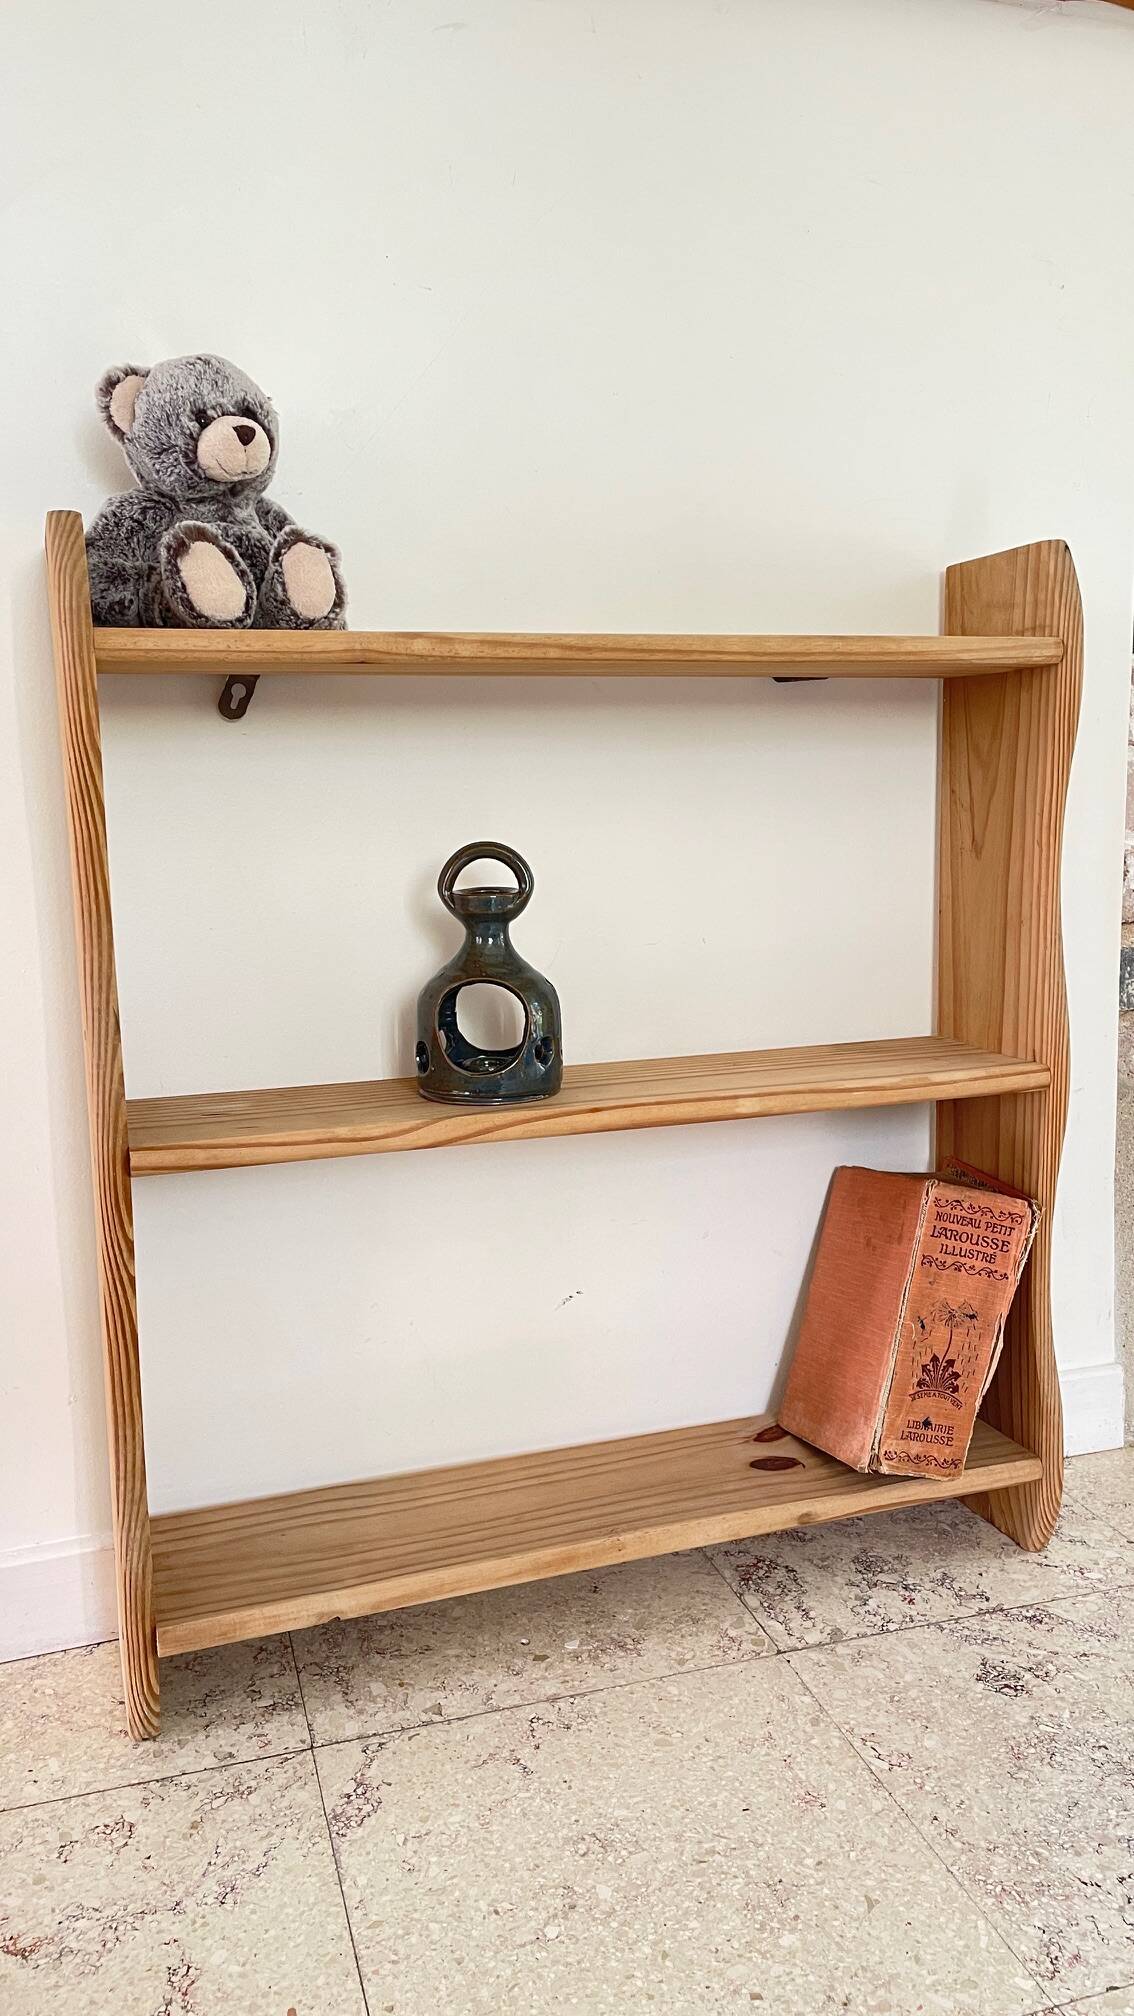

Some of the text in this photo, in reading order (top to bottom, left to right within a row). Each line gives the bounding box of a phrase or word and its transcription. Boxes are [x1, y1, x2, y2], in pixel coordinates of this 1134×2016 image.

[935, 1211, 1015, 1236] NOUVEAU PETIT
[930, 1225, 1011, 1253] LAROUSSE
[939, 1243, 997, 1264] ILLUSTRÉ
[901, 1430, 954, 1447] LAROUSSE
